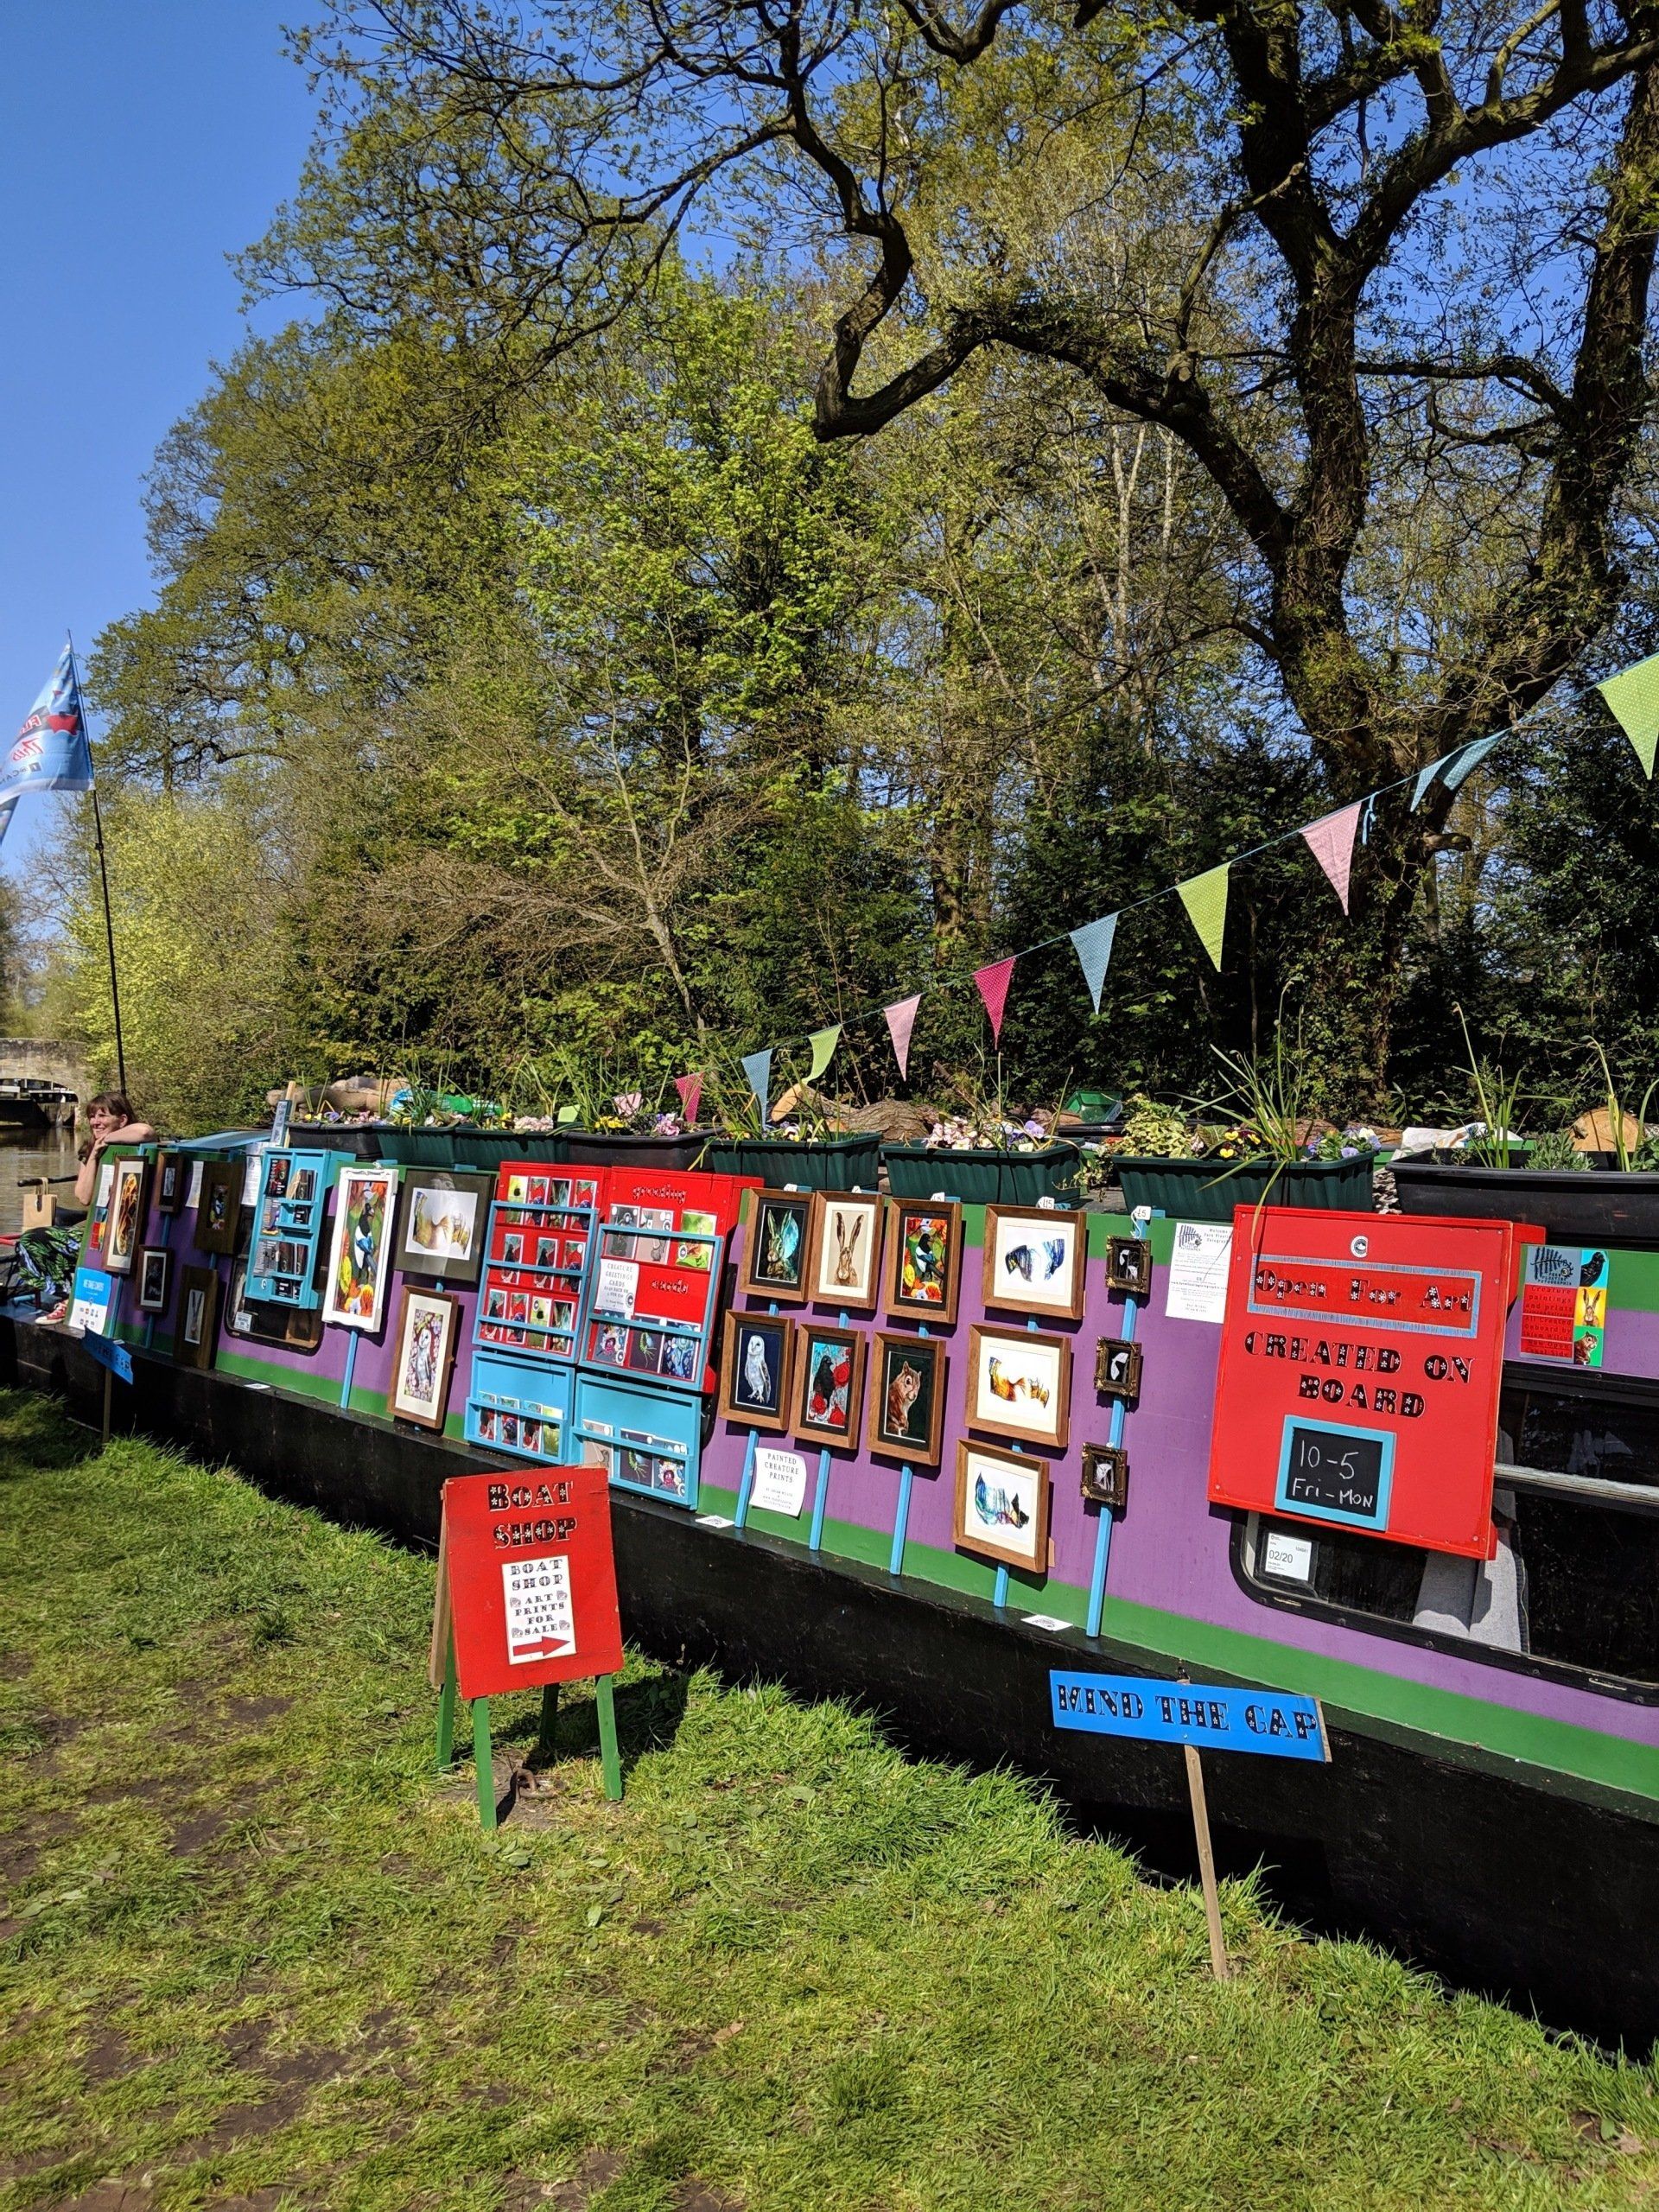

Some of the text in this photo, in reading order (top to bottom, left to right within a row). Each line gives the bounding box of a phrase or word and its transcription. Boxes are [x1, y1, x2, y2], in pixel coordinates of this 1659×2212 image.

[1137, 1208, 1147, 1217] £5
[1255, 1269, 1471, 1313] Open For Art
[1531, 1286, 1571, 1294] Creature
[1529, 1294, 1571, 1304] paintings
[1244, 1331, 1475, 1383] CREATED ON
[1297, 1373, 1426, 1418] BOARD
[767, 1452, 797, 1465] PAINTED
[765, 1461, 799, 1475] CREATURE
[769, 1471, 793, 1483] PRINTS
[488, 1481, 574, 1512] BOAT
[493, 1517, 577, 1549] SHOP
[1268, 1549, 1294, 1564] 02/20
[510, 1559, 563, 1575] BOAT
[512, 1574, 563, 1591] SHOP
[525, 1593, 553, 1605] ART
[515, 1602, 564, 1616] PRINTS
[527, 1614, 554, 1624] FOR
[524, 1624, 557, 1636] SALE
[1056, 1685, 1318, 1740] MIND THE GAP
